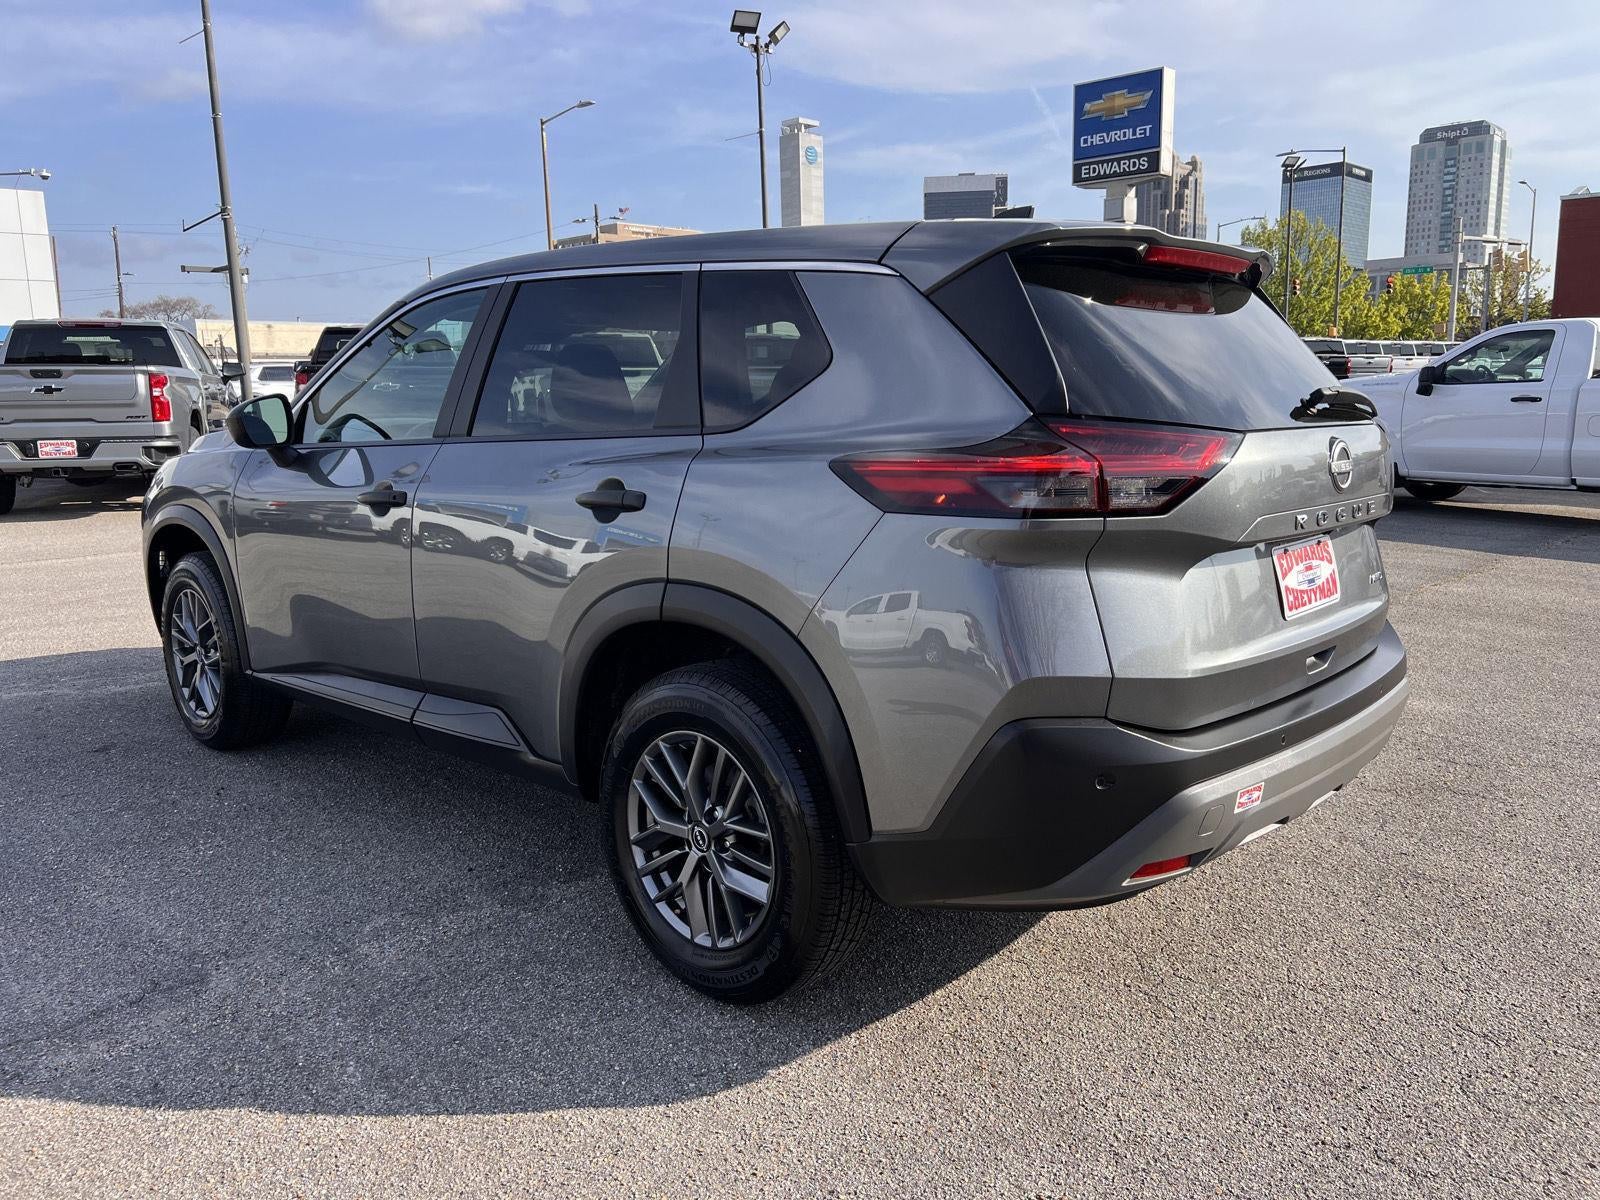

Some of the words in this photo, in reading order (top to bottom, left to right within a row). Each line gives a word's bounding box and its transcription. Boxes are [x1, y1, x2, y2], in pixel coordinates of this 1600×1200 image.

[1080, 125, 1152, 147] CHEVROLET
[1437, 129, 1461, 138] Shipt
[1081, 157, 1148, 177] EDWARDS
[1295, 500, 1376, 530] ROGUE
[1277, 541, 1333, 581] EDWARDS
[1285, 568, 1338, 612] CHEVYMAN
